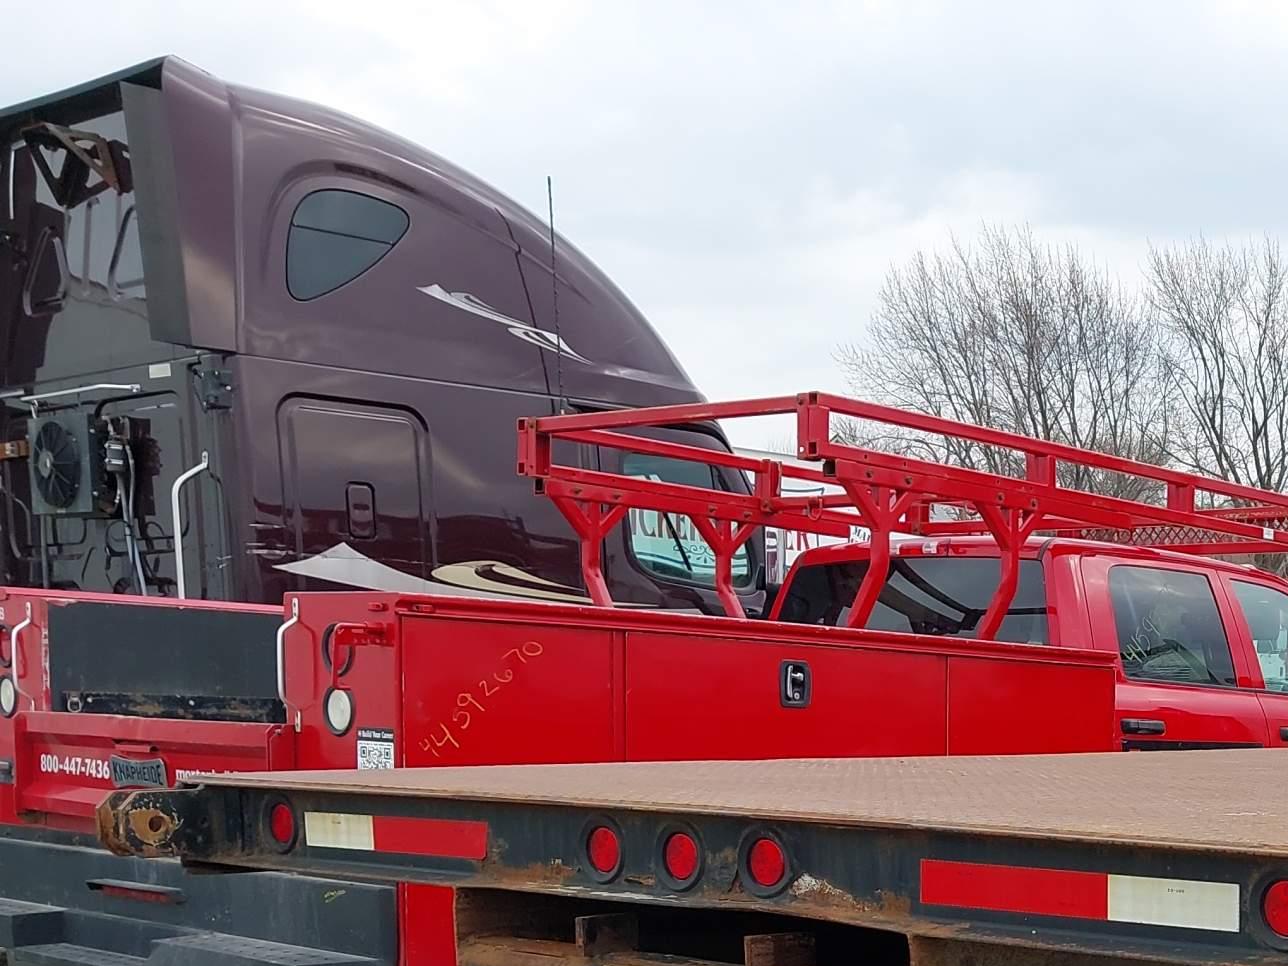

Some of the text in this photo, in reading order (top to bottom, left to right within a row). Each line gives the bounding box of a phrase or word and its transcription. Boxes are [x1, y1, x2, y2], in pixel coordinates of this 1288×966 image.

[418, 641, 543, 757] 44592670
[40, 754, 110, 779] 800-447-7436
[112, 762, 164, 786] KNAPHEIDE
